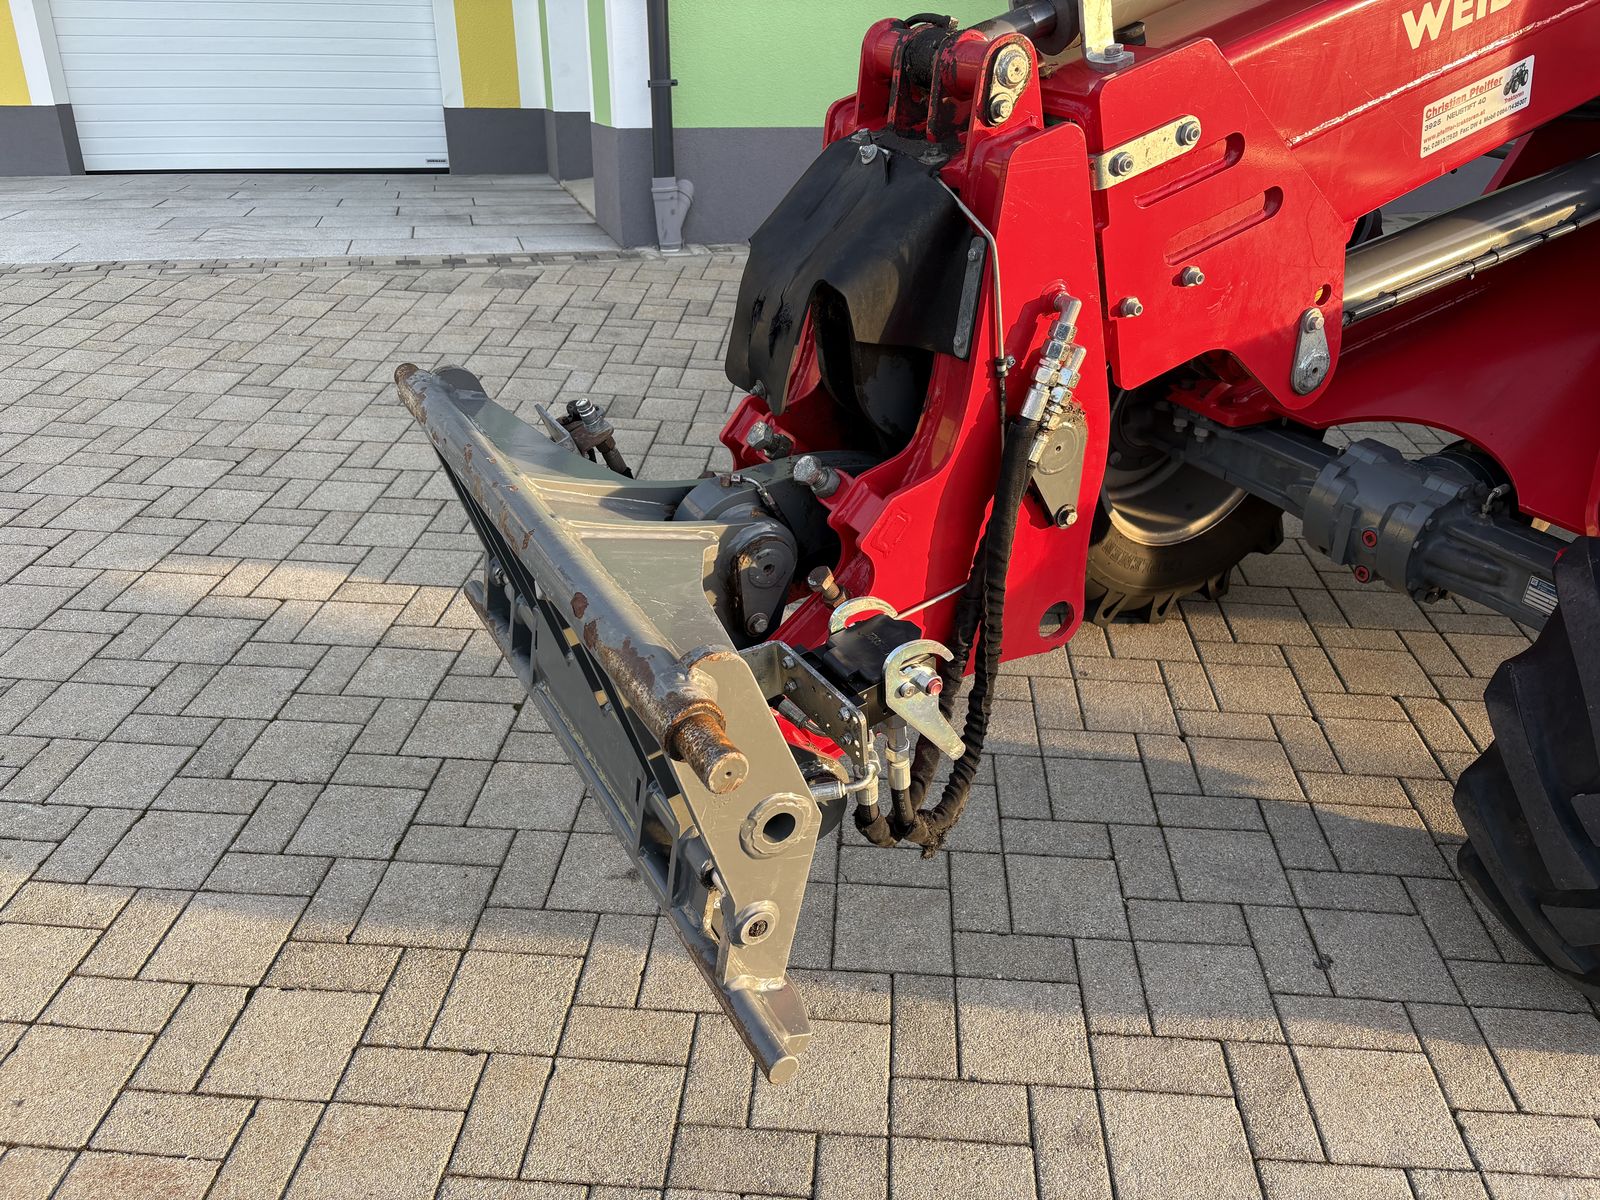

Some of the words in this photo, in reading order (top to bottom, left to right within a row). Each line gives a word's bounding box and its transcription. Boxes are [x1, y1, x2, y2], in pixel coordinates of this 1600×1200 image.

[1402, 0, 1511, 50] WEI
[1424, 119, 1442, 132] 3925
[1446, 101, 1477, 121] NEUSTIFT
[1477, 96, 1487, 106] 40
[1425, 93, 1467, 119] Christian
[1469, 76, 1504, 99] Pfeiffer
